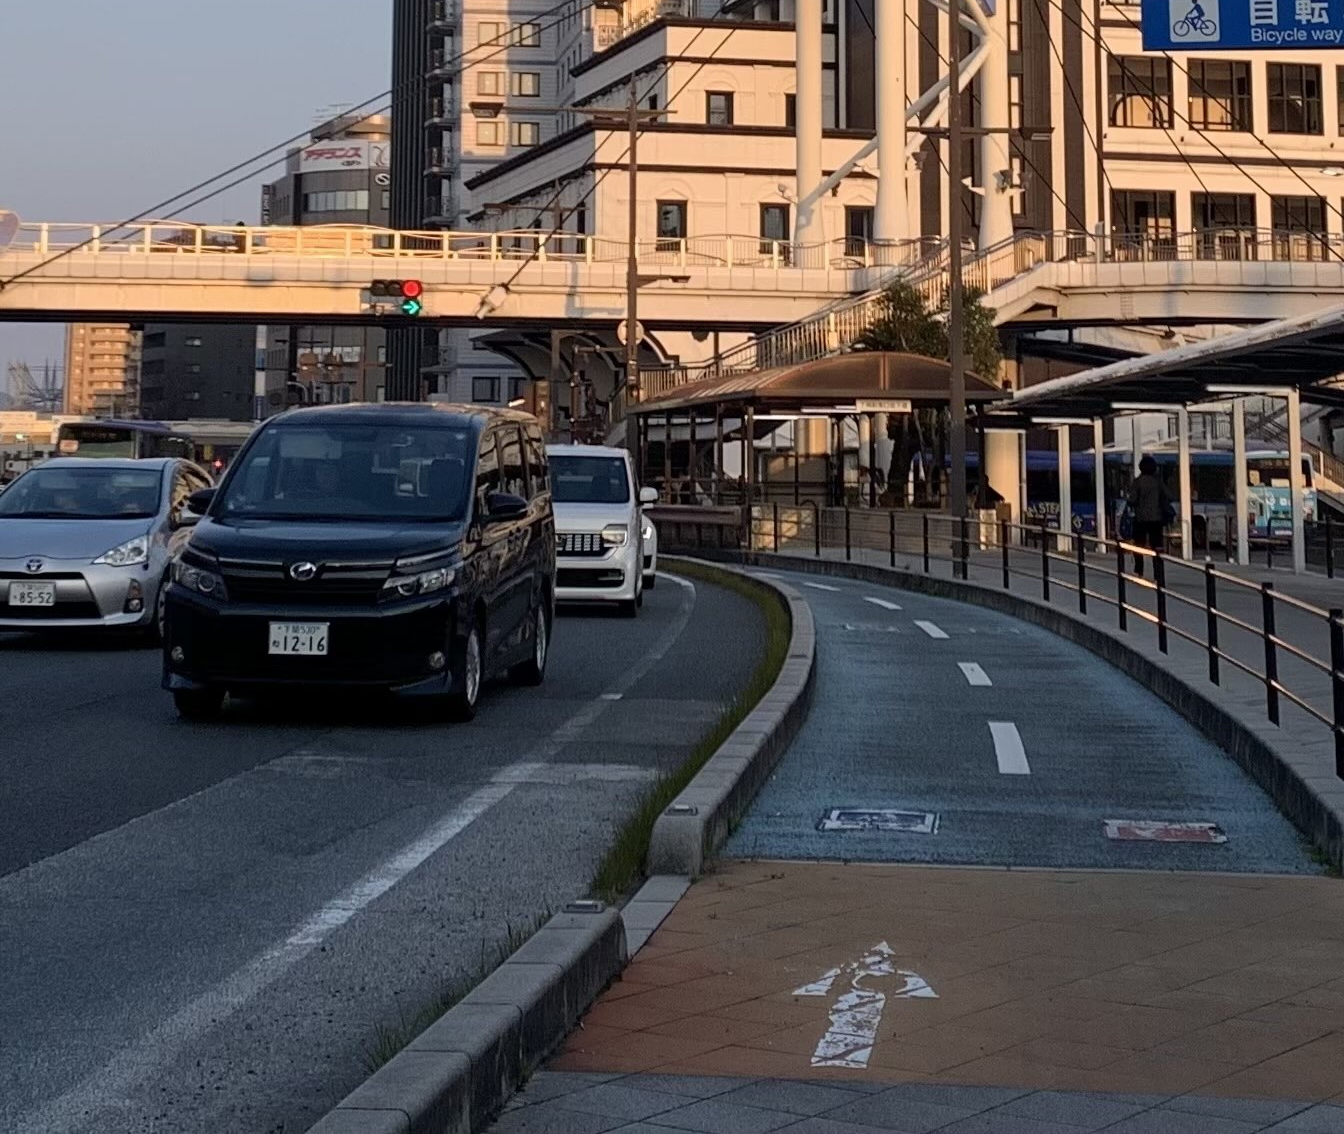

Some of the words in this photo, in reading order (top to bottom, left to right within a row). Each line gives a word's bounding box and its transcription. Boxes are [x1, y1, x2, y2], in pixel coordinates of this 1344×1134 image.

[1250, 27, 1308, 43] Bicycle
[1312, 29, 1344, 43] way
[283, 635, 325, 652] 12-16
